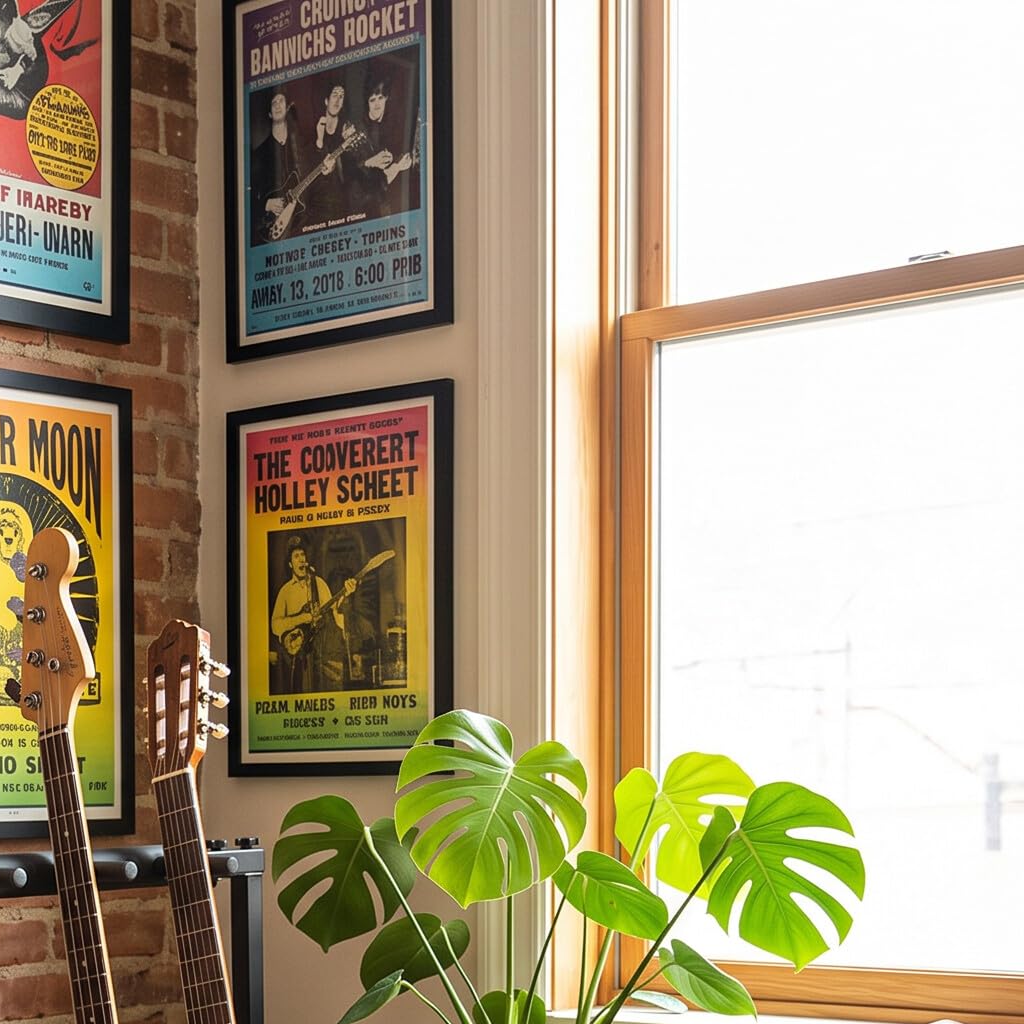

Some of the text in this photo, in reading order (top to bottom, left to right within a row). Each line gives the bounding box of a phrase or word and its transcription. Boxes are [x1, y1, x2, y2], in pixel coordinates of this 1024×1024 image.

[344, 0, 418, 48] ROCKET
[289, 279, 309, 300] 13,
[312, 270, 344, 297] 2018
[355, 261, 385, 287] 6:00
[29, 418, 102, 540] MOON
[254, 450, 292, 481] THE
[255, 465, 419, 514] HOLLEY SCHEET
[382, 693, 417, 709] NOYS
